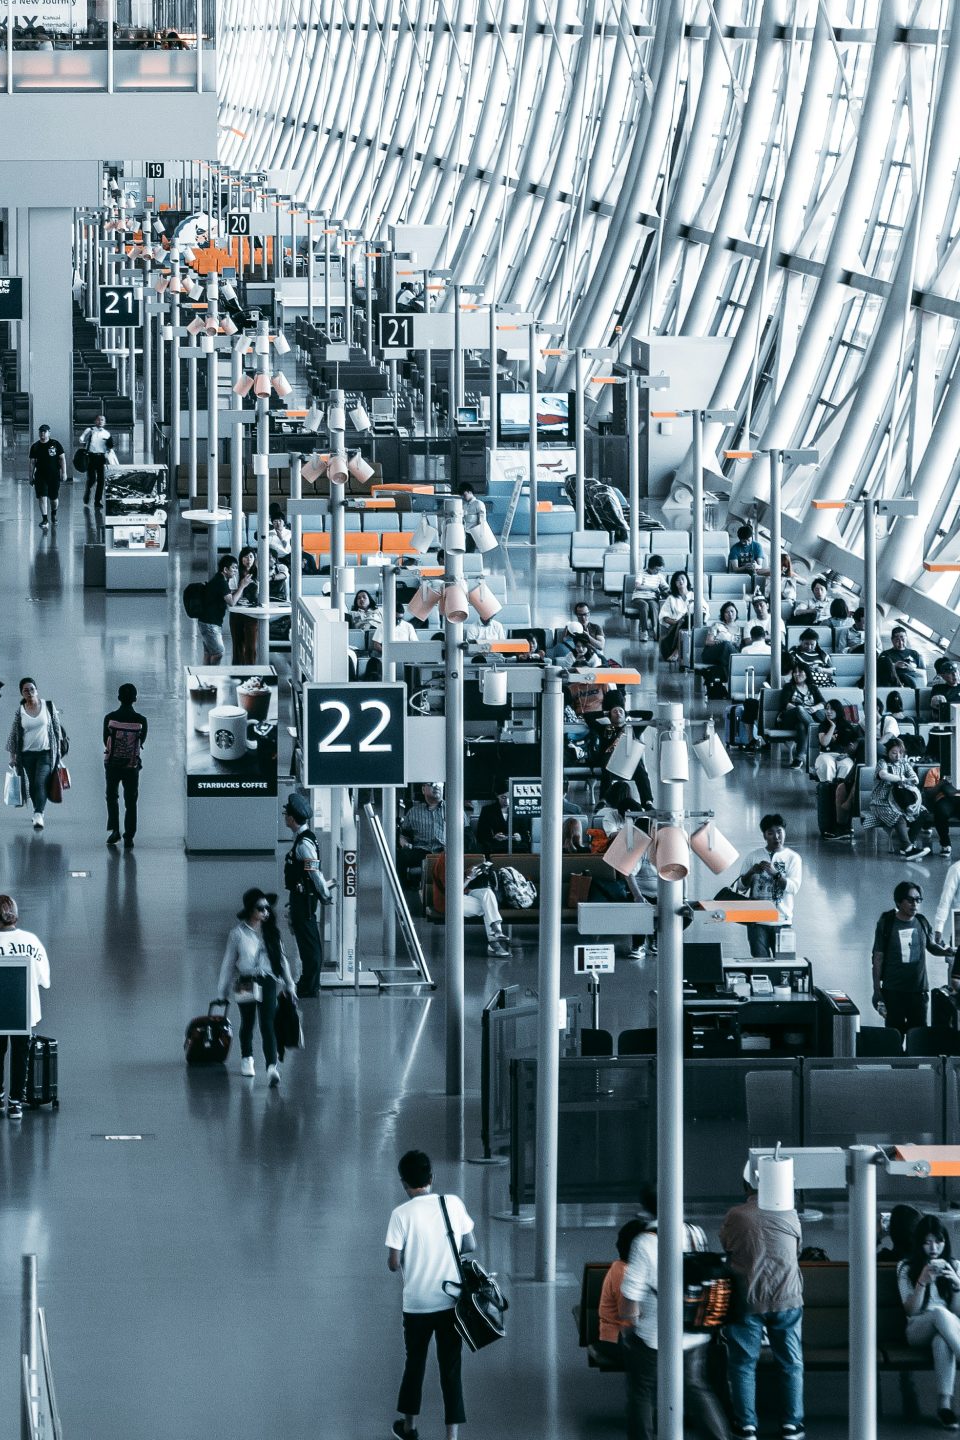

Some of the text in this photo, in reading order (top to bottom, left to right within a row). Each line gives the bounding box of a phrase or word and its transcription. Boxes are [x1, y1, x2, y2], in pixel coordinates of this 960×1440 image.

[150, 164, 162, 177] 19
[231, 215, 246, 233] 20
[105, 291, 133, 314] 21
[388, 319, 408, 345] 21
[318, 700, 392, 752] 22
[346, 865, 356, 896] AED
